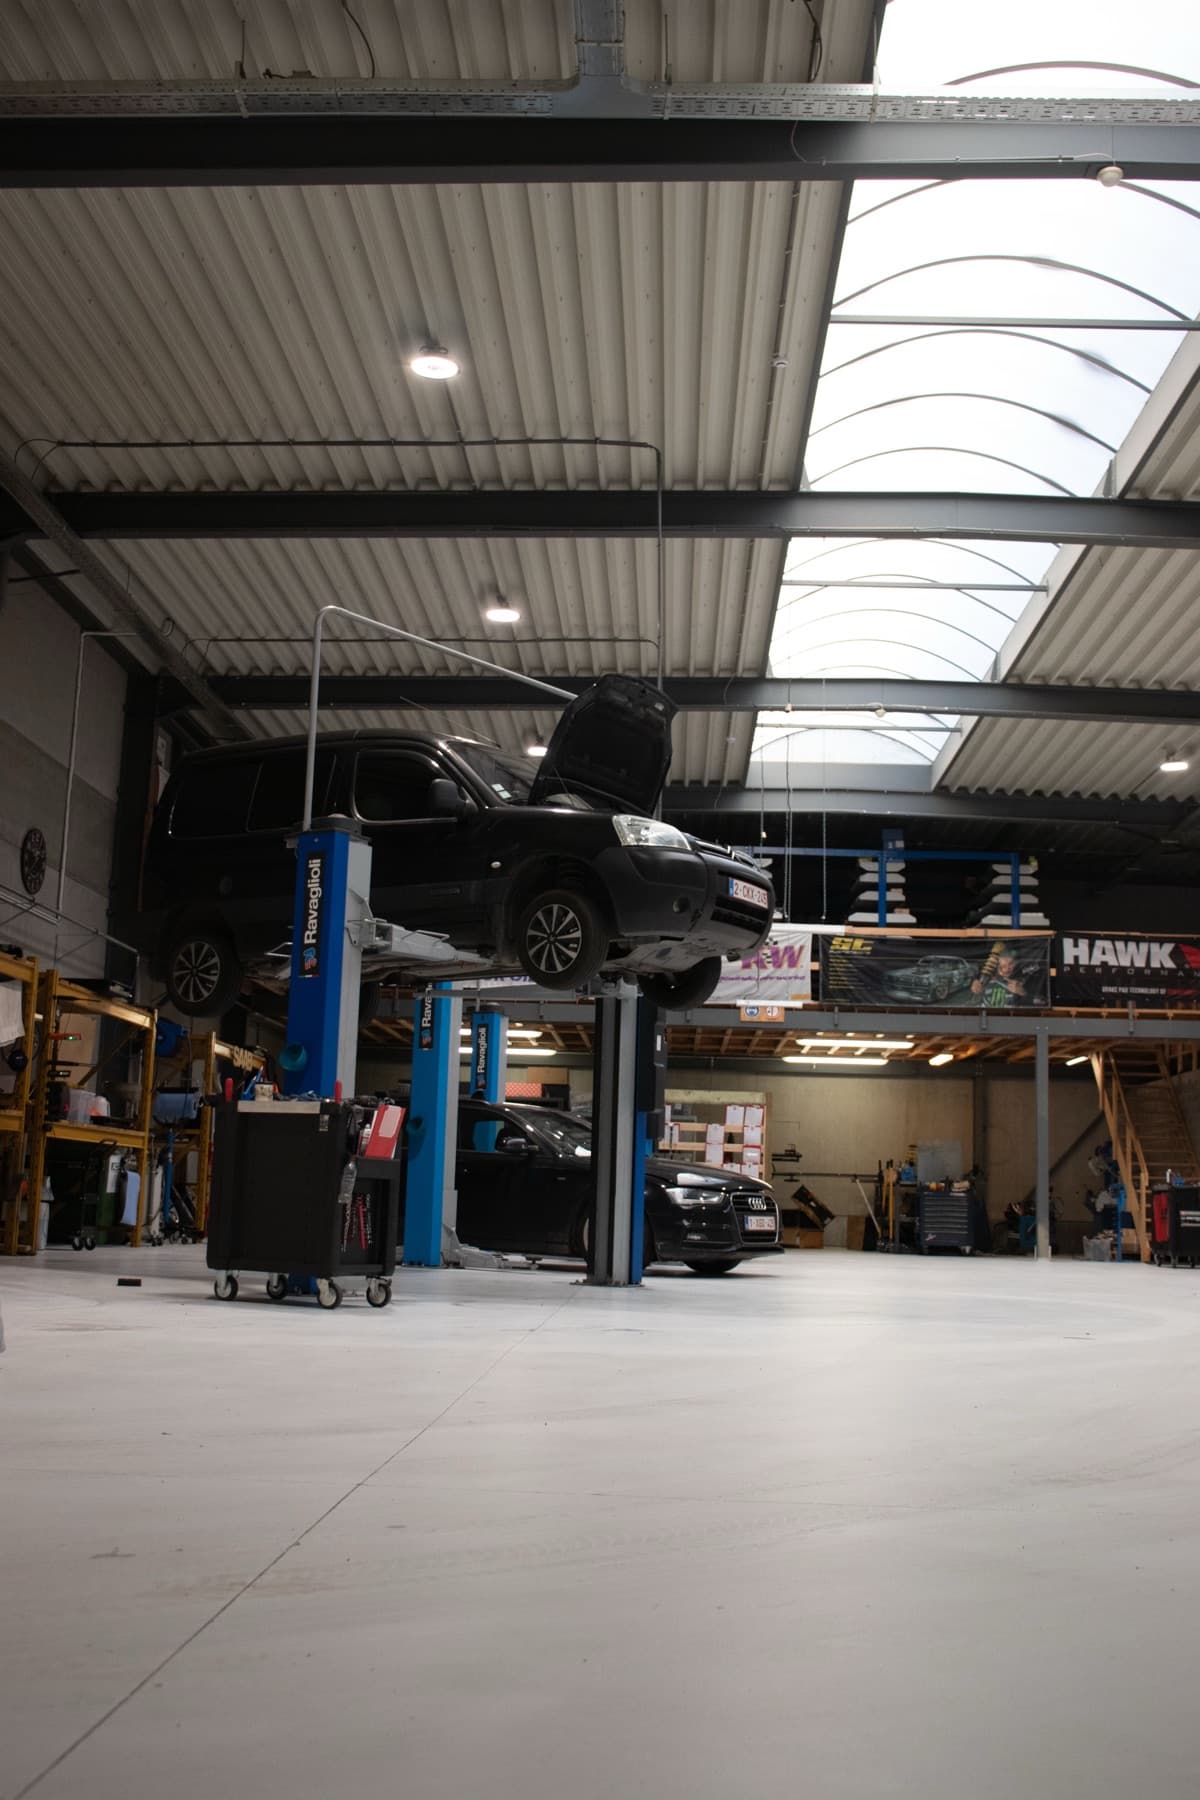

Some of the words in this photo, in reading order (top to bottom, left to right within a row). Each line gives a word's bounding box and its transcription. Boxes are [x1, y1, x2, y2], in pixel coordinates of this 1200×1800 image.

[304, 859, 321, 944] Ravaglioli
[1063, 937, 1177, 968] HAWK
[477, 1027, 487, 1073] Ravaglioli
